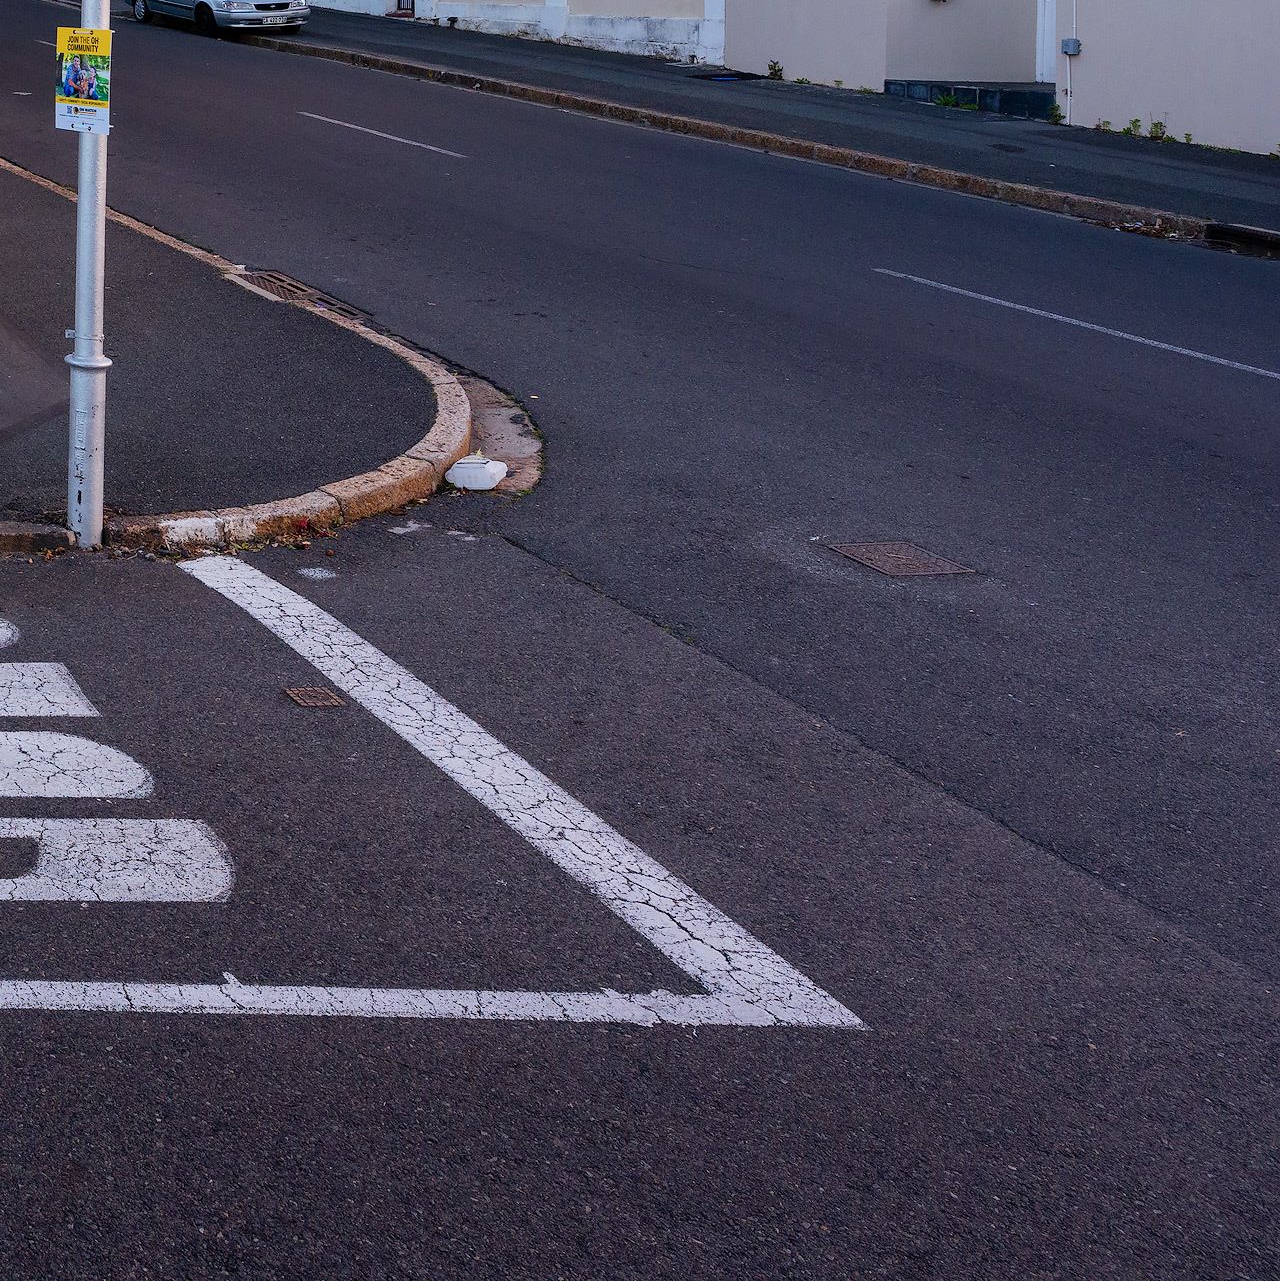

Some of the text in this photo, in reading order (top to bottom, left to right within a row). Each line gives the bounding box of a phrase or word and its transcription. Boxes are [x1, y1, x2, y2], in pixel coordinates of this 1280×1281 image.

[67, 35, 100, 45] JOIN THE OH
[67, 43, 99, 53] COMMUNITY
